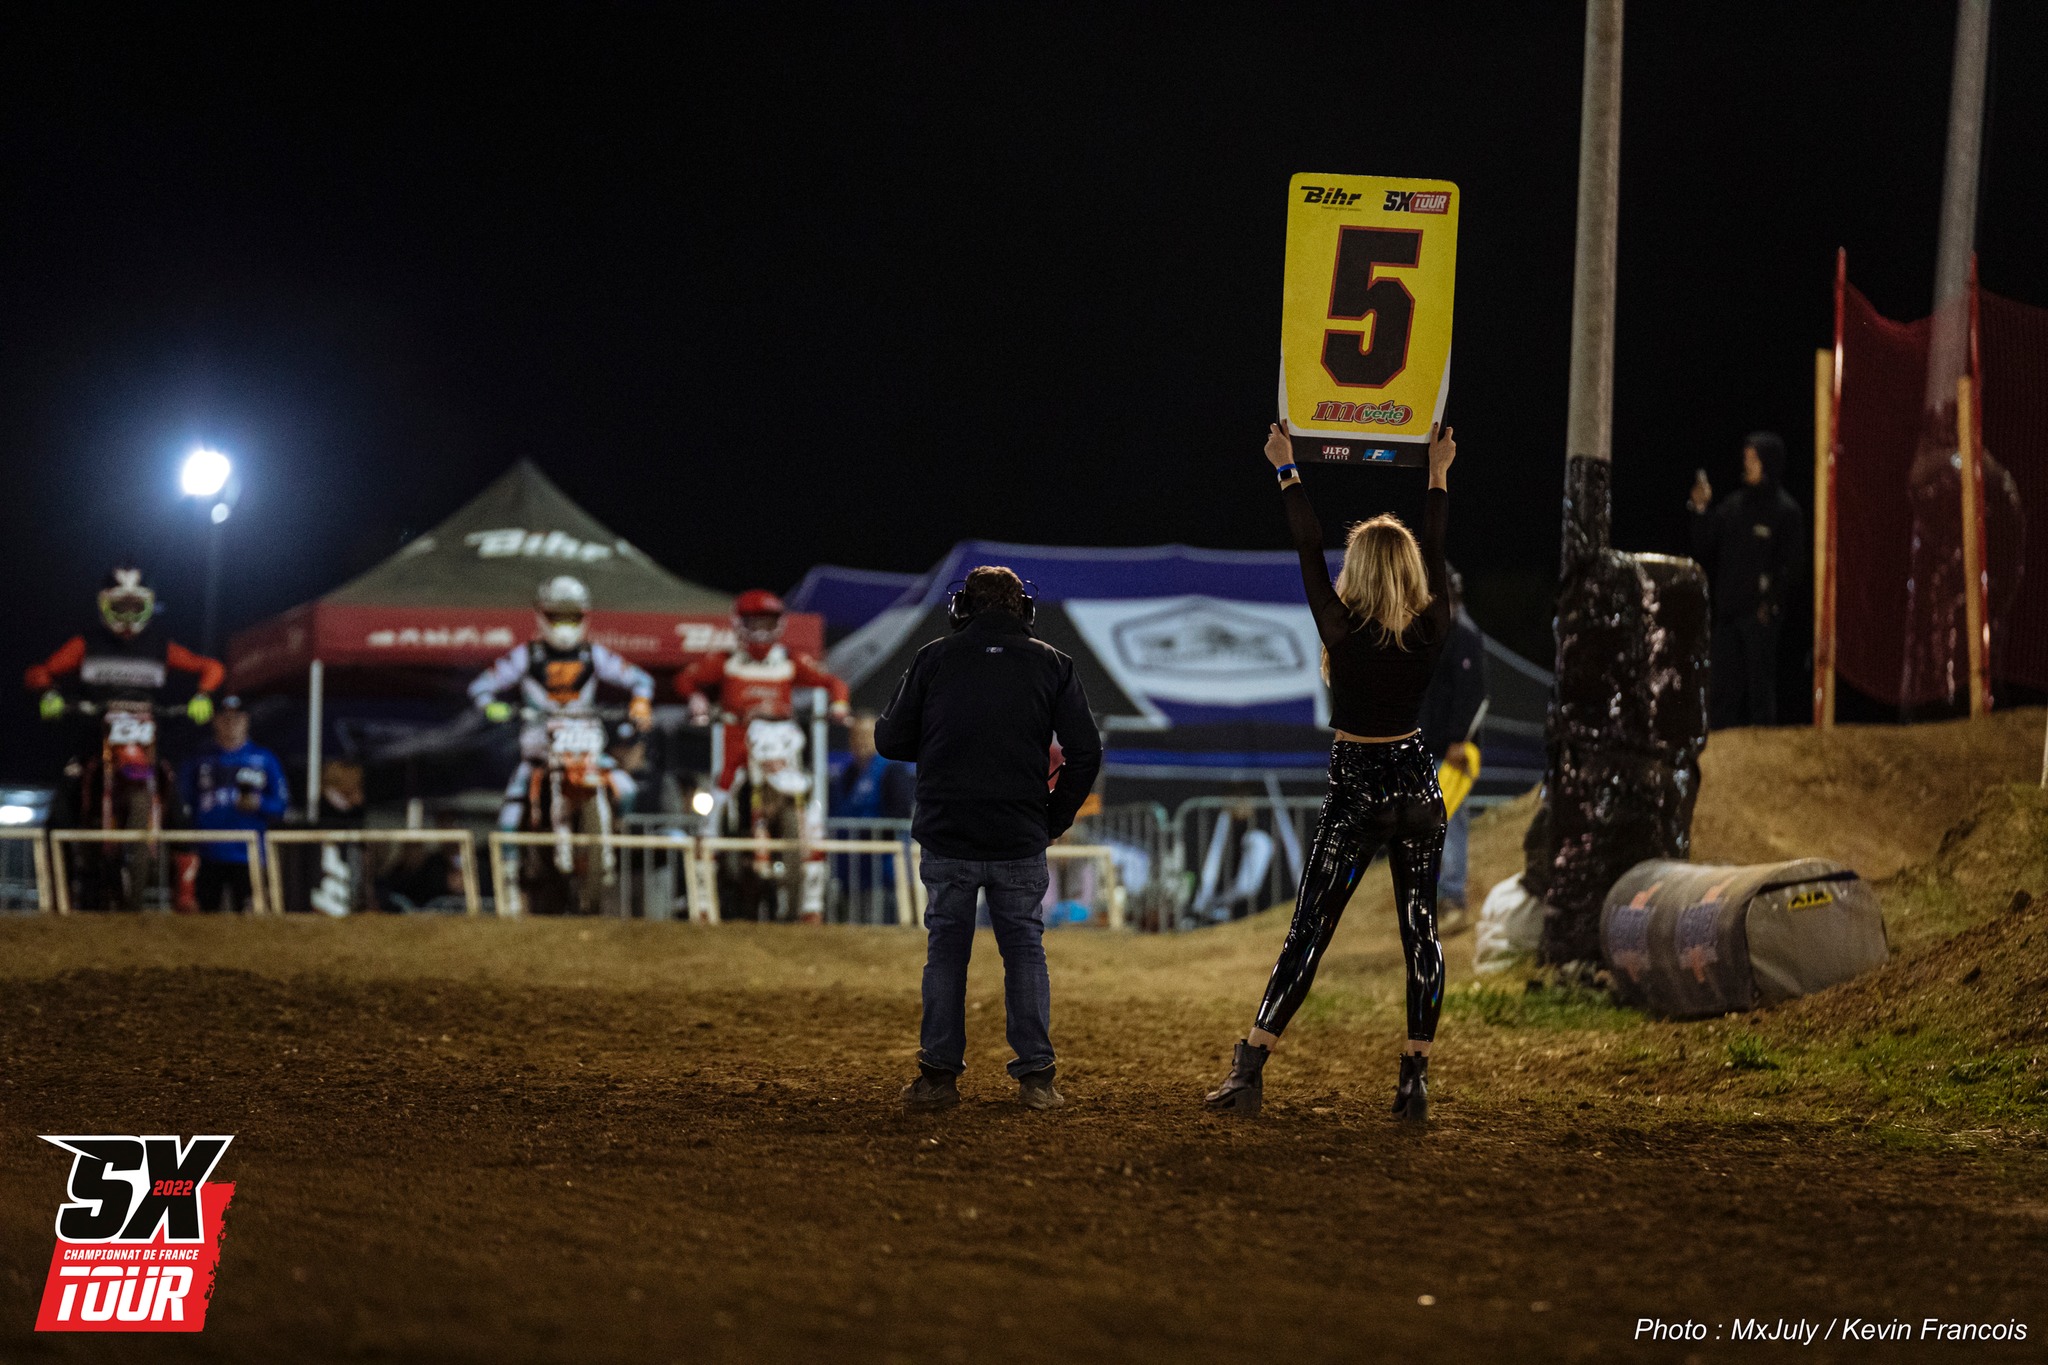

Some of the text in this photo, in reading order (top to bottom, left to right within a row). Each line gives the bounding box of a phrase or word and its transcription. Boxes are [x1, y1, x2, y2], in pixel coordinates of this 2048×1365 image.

[1300, 186, 1362, 206] Bihr
[1383, 190, 1448, 212] SX TOUR
[1320, 225, 1424, 389] 5
[1311, 400, 1413, 426] moto
[1363, 408, 1404, 421] verte
[1322, 446, 1350, 455] JLFO
